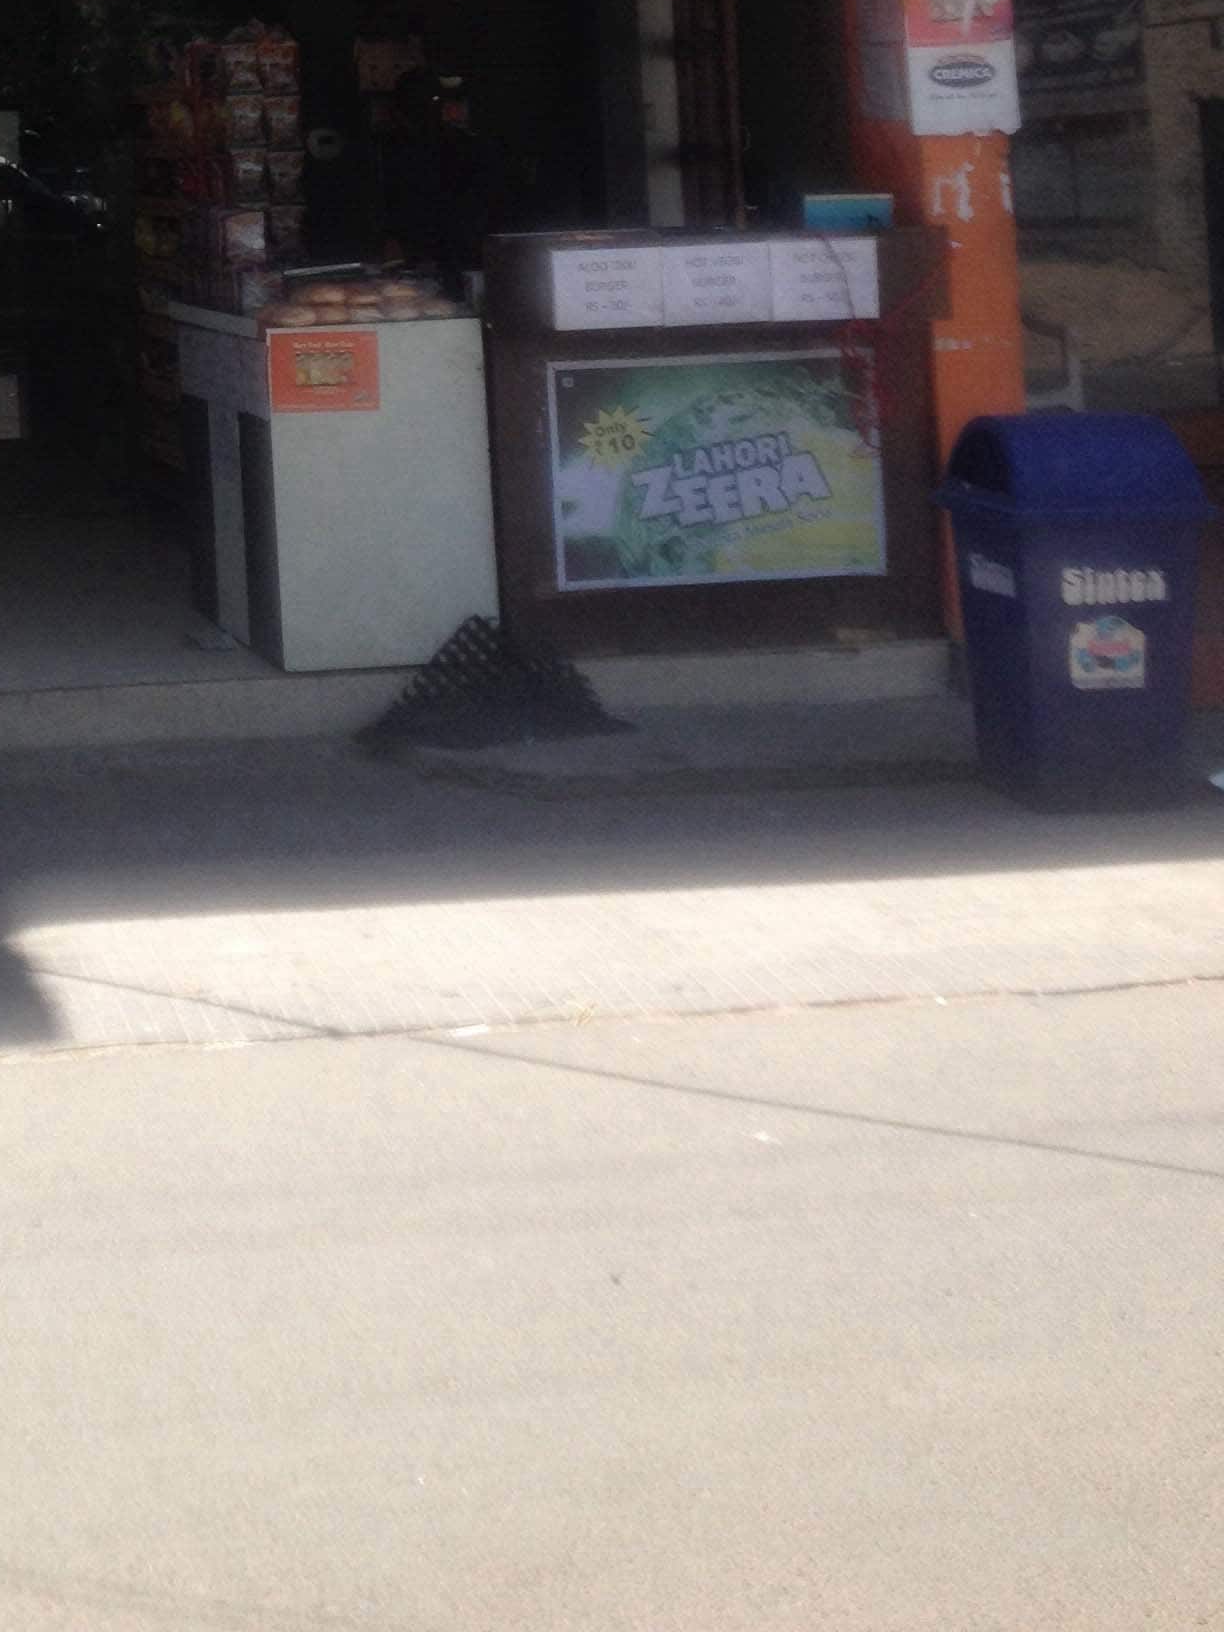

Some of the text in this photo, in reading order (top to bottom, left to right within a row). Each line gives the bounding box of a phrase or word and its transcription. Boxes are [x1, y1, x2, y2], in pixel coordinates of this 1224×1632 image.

[594, 422, 627, 438] Only
[607, 434, 636, 455] 10
[675, 431, 791, 478] LAHORI
[631, 450, 834, 529] ZEERA
